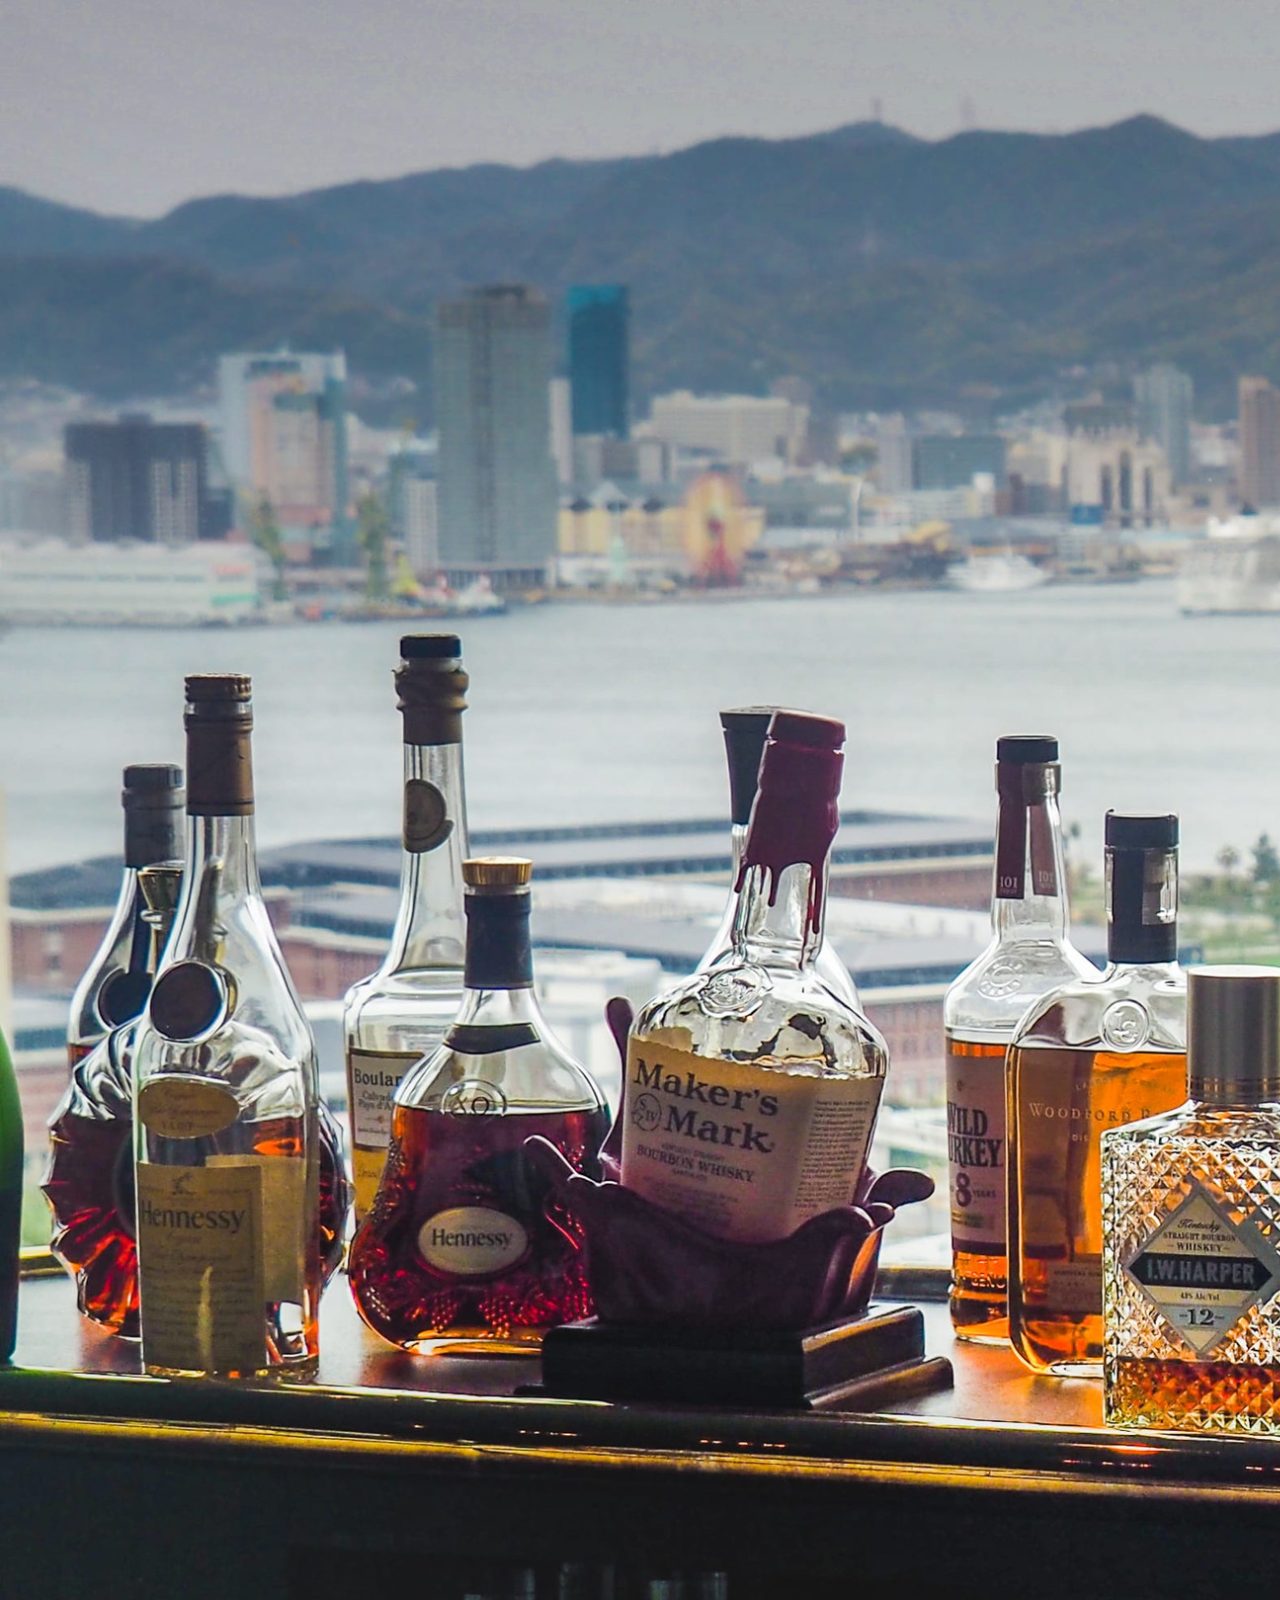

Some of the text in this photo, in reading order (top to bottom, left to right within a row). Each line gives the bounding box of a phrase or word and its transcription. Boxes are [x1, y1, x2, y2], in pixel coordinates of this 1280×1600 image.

[1000, 876, 1018, 889] 101
[633, 1059, 779, 1117] Maker's
[948, 1101, 987, 1137] WILD
[1029, 1103, 1131, 1122] WOODFORD
[664, 1104, 772, 1154] Mark
[637, 1143, 694, 1169] BOURBON
[698, 1159, 755, 1183] WHISKY
[948, 1133, 1003, 1168] URKEY
[956, 1172, 972, 1207] 8
[141, 1203, 245, 1233] Hennessy
[432, 1228, 512, 1250] Hennessy
[1164, 1232, 1236, 1242] STRAIGHT BOURBON
[1177, 1242, 1223, 1252] WHISKEY
[1187, 1309, 1214, 1326] 12
